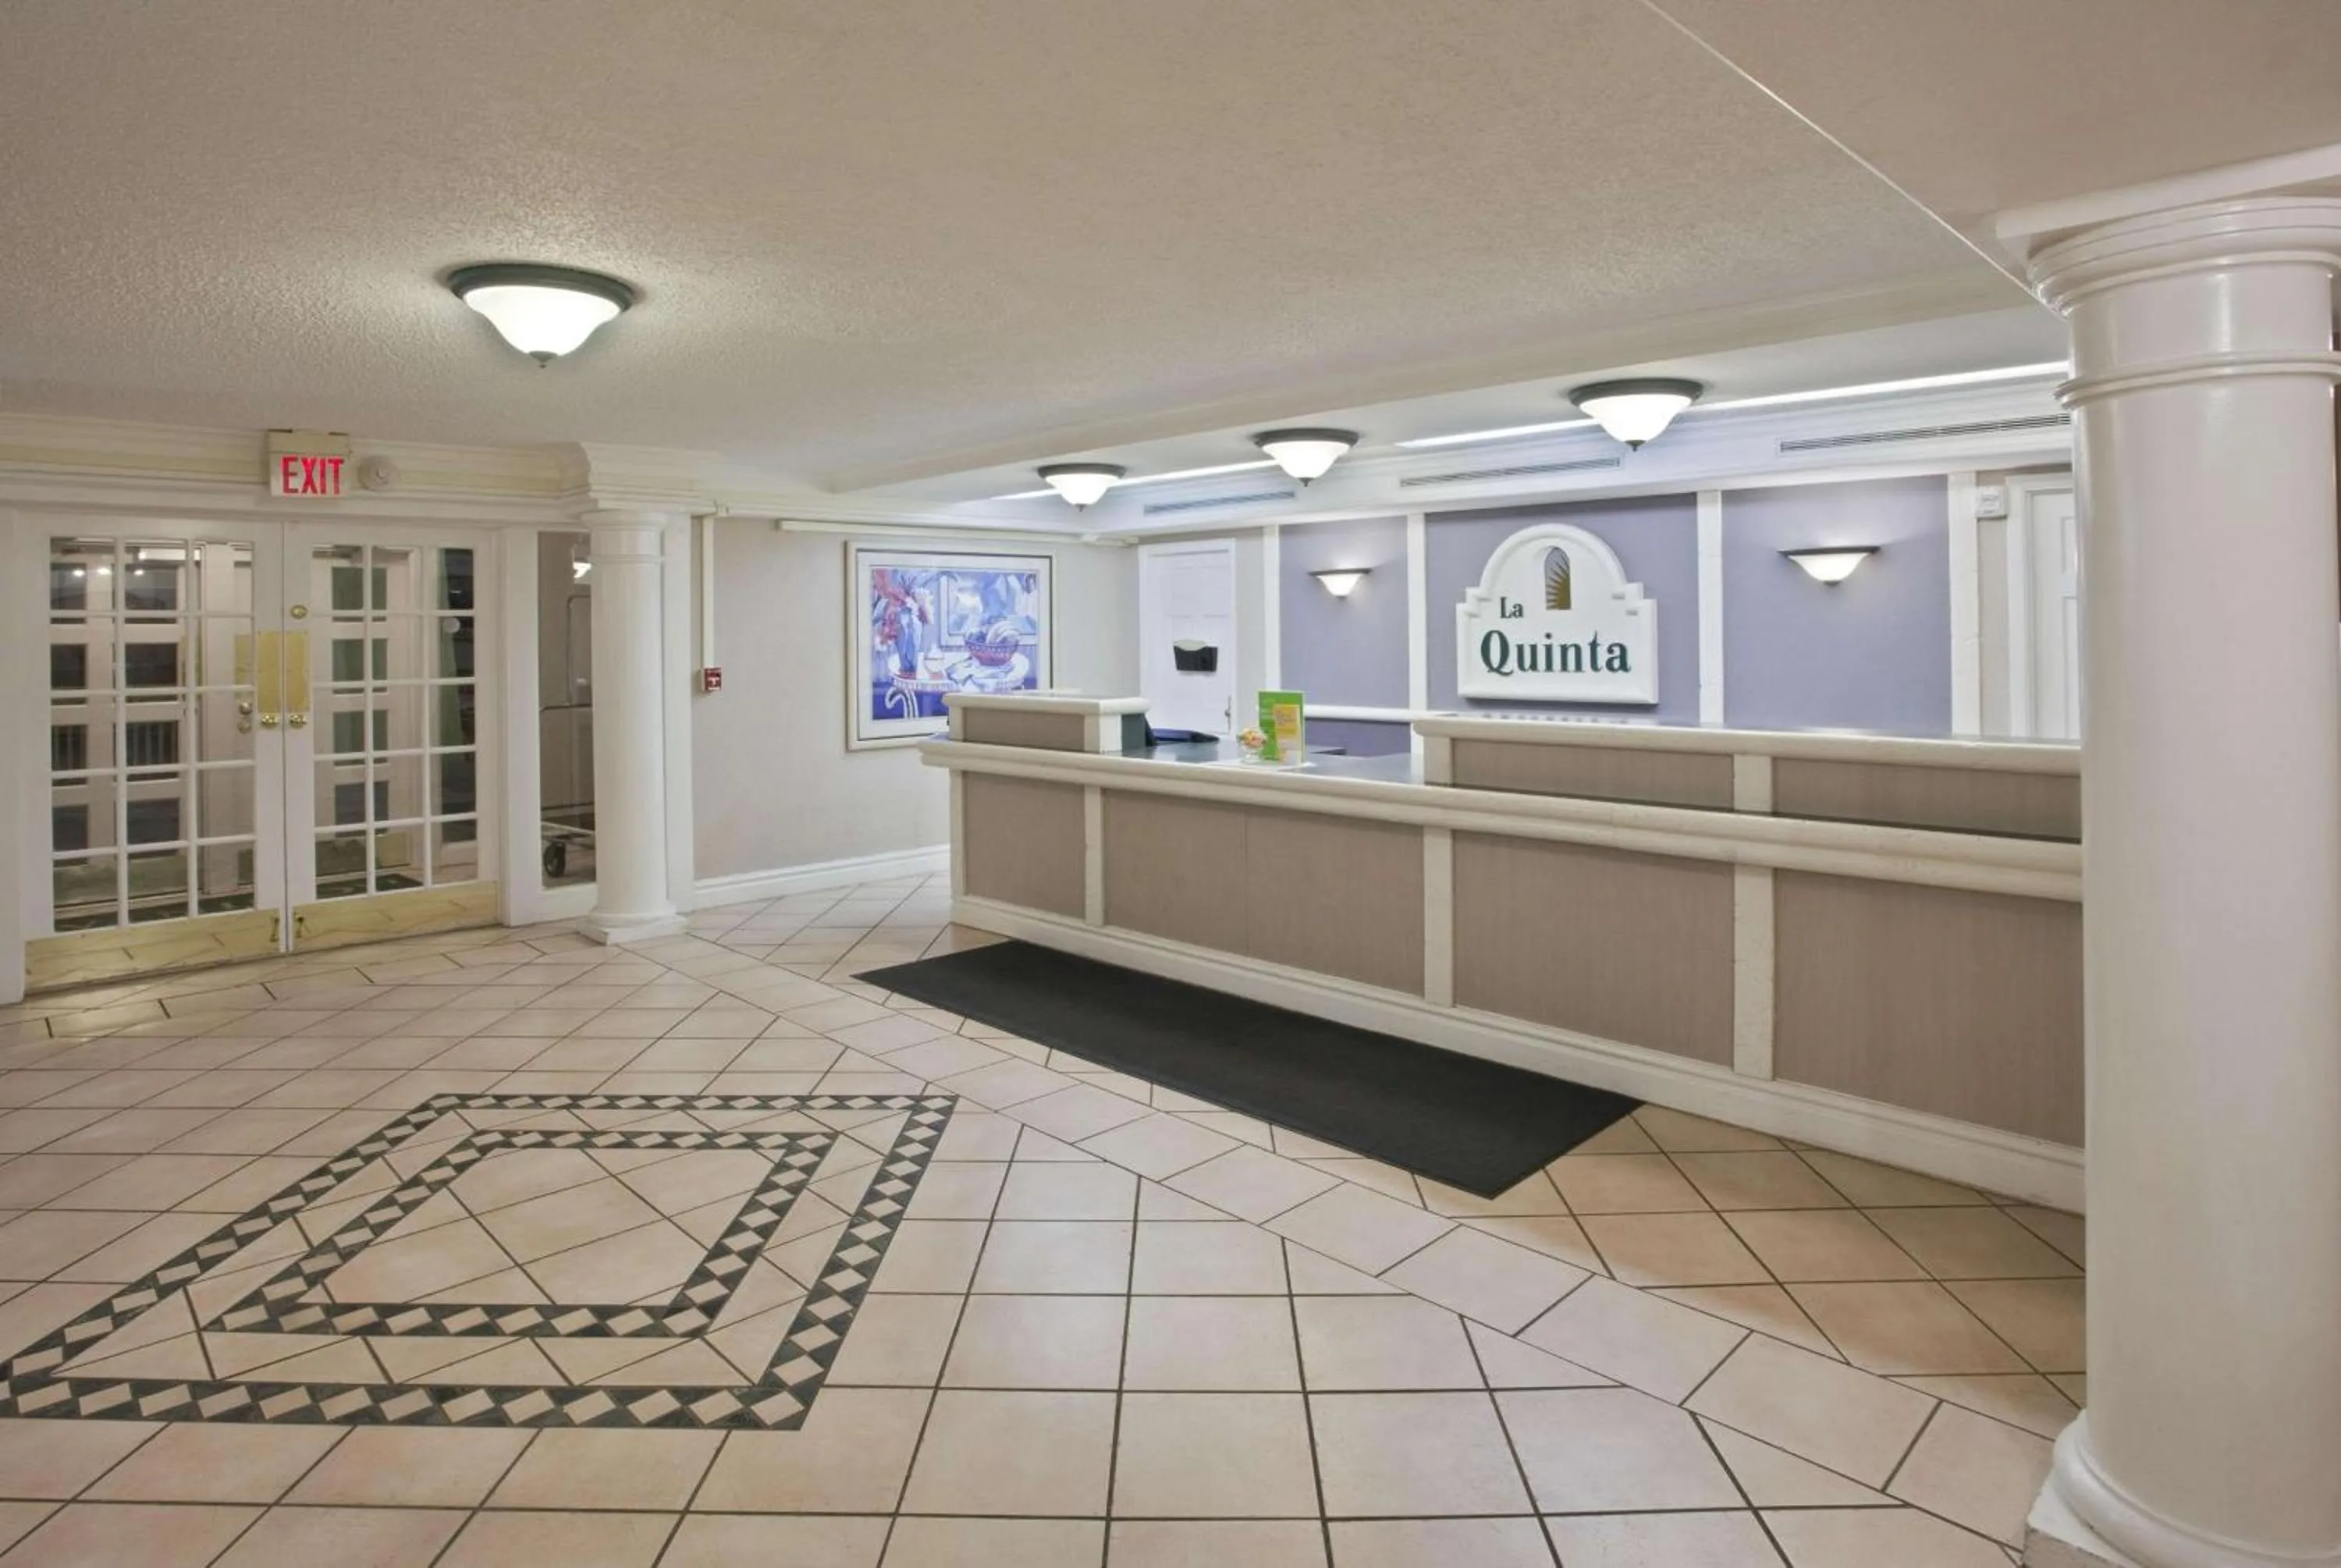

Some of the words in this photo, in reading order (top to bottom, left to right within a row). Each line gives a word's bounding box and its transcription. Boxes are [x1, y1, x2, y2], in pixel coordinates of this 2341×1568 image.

[282, 455, 344, 495] EXIT
[1500, 597, 1524, 619] La
[1480, 629, 1632, 677] Quinta
